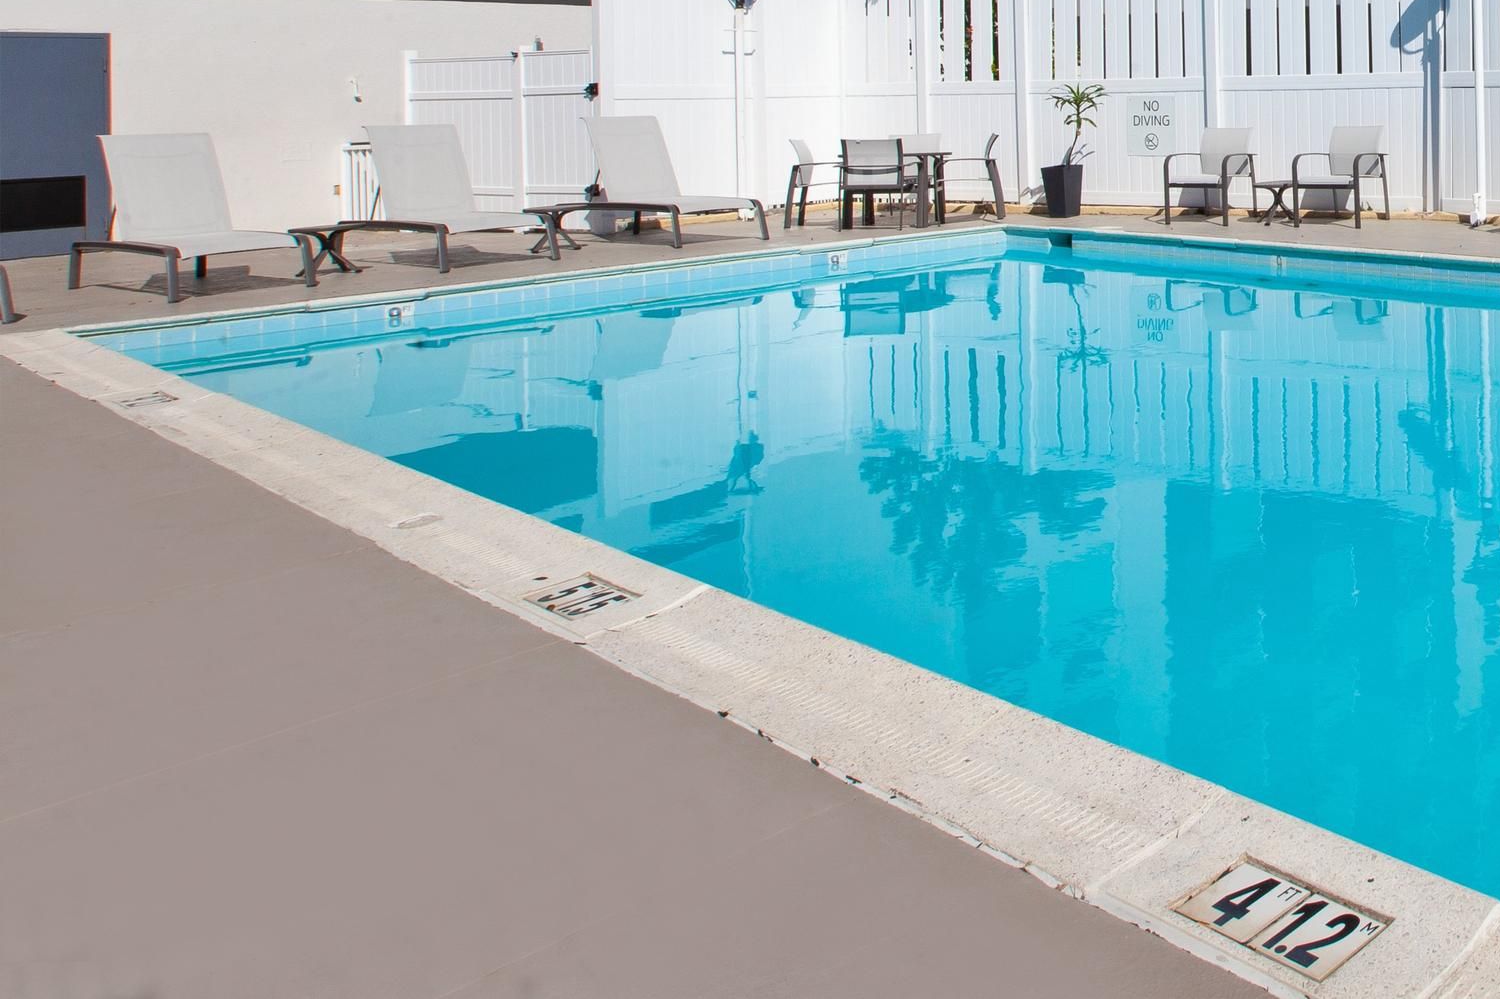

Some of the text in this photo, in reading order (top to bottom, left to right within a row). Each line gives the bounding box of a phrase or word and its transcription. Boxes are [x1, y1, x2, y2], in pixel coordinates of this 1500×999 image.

[1143, 100, 1160, 111] NO
[1133, 115, 1170, 126] DIVING
[1212, 878, 1380, 968] 4 FT 1.2 M
